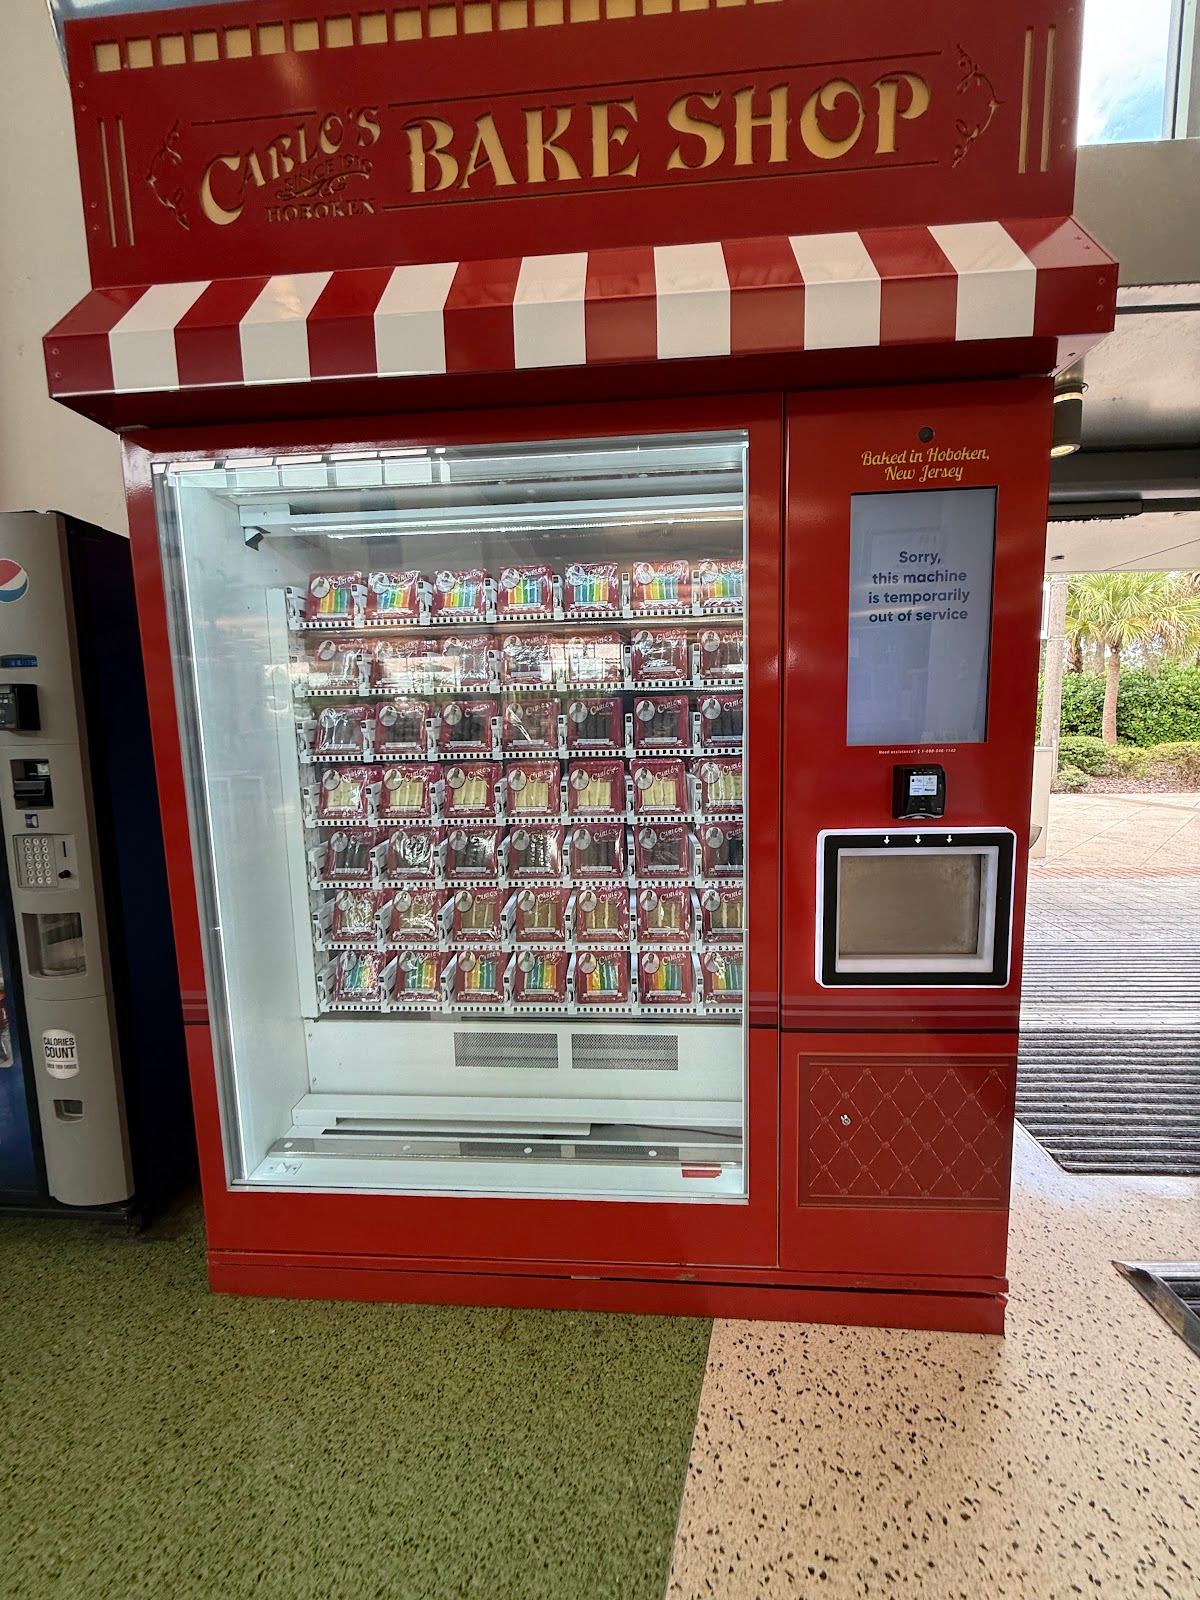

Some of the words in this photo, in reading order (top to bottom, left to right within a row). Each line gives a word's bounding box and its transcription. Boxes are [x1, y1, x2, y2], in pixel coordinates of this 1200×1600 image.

[200, 105, 381, 225] CARLO'S
[402, 97, 640, 193] BAKE
[666, 70, 931, 171] SHOP
[266, 199, 376, 223] HOBOKEN
[861, 450, 906, 466] Baked
[910, 450, 923, 463] in
[926, 447, 990, 462] Hoboken,
[884, 466, 915, 481] New
[919, 465, 964, 482] Jersey
[899, 551, 941, 565] Sorry,
[872, 571, 899, 584] this
[903, 570, 967, 583] machine
[868, 592, 880, 604] is
[884, 588, 970, 605] temporarily
[869, 611, 893, 623] out
[897, 610, 912, 622] of
[916, 608, 968, 621] service
[43, 1037, 74, 1046] CALORIES
[45, 1046, 75, 1058] COUNT
